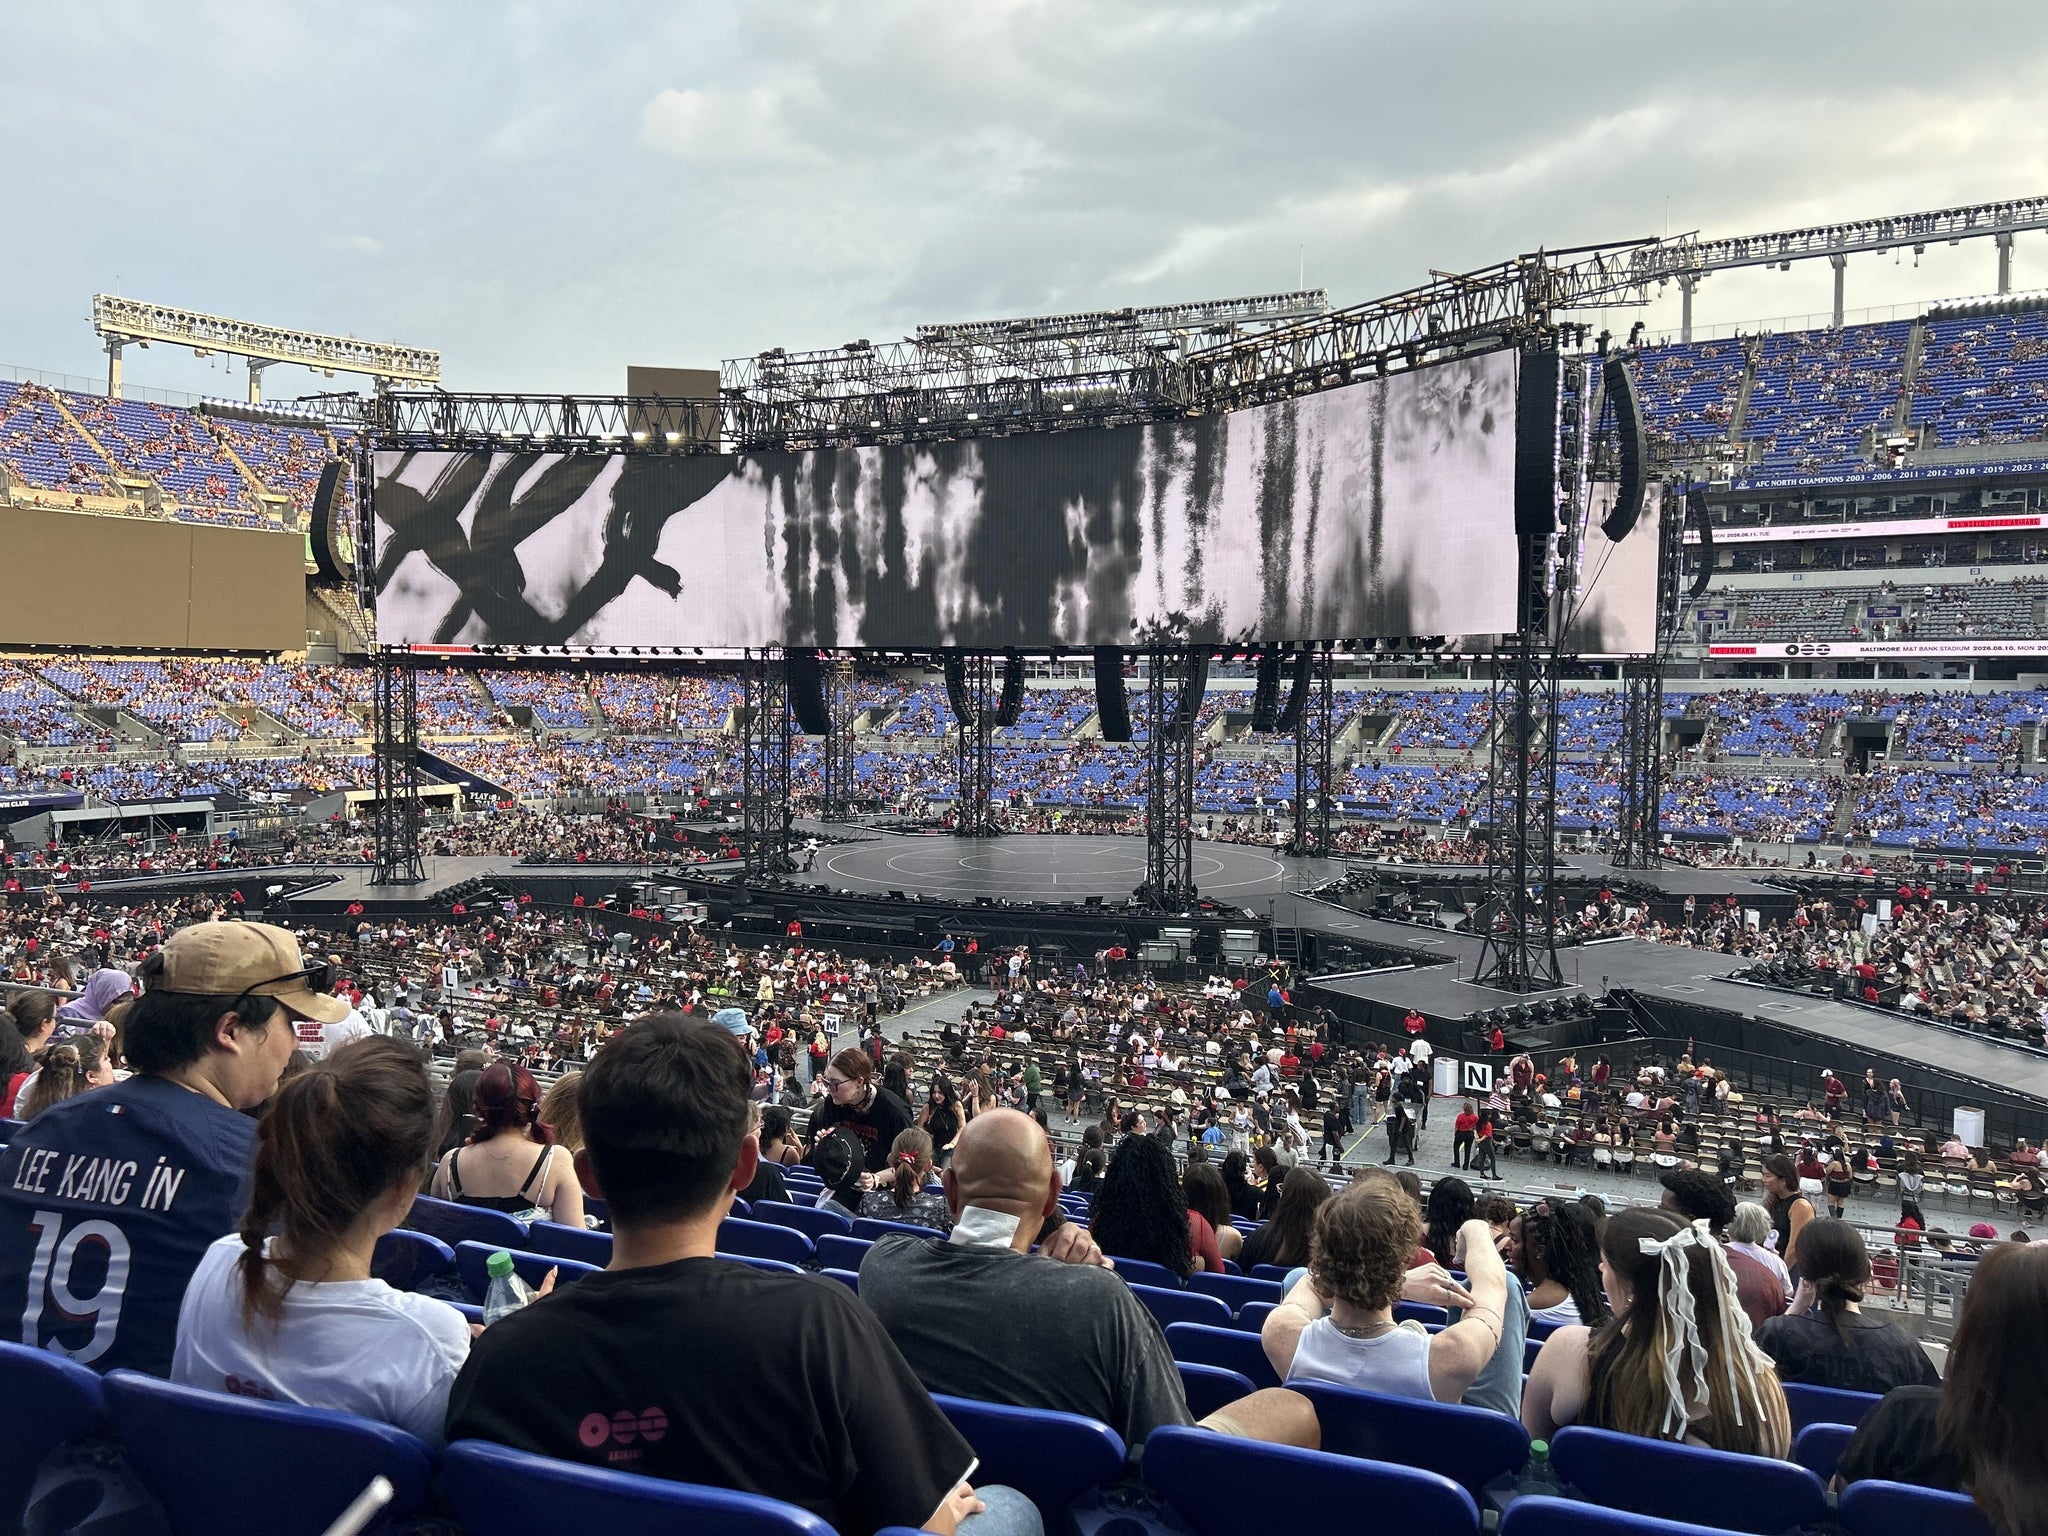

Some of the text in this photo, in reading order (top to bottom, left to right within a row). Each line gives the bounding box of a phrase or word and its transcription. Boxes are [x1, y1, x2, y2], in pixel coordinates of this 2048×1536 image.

[1755, 480, 1770, 488] AFC
[1771, 478, 1797, 487] NORTH
[1798, 476, 1844, 485] CHAMPIONS
[1845, 474, 1865, 482] 2003
[1872, 472, 1892, 480] 2006
[1899, 471, 1919, 479] 2011
[1926, 469, 1947, 477] 2012
[1954, 467, 1976, 476] 2018
[1982, 466, 2004, 474] 2019
[2011, 464, 2033, 472] 2023
[470, 791, 488, 800] PLAY
[445, 970, 454, 987] L
[826, 1020, 837, 1031] M
[1468, 1065, 1487, 1089] N
[13, 1146, 60, 1194] LEE
[56, 1154, 138, 1206] KANG
[22, 1209, 131, 1364] 19
